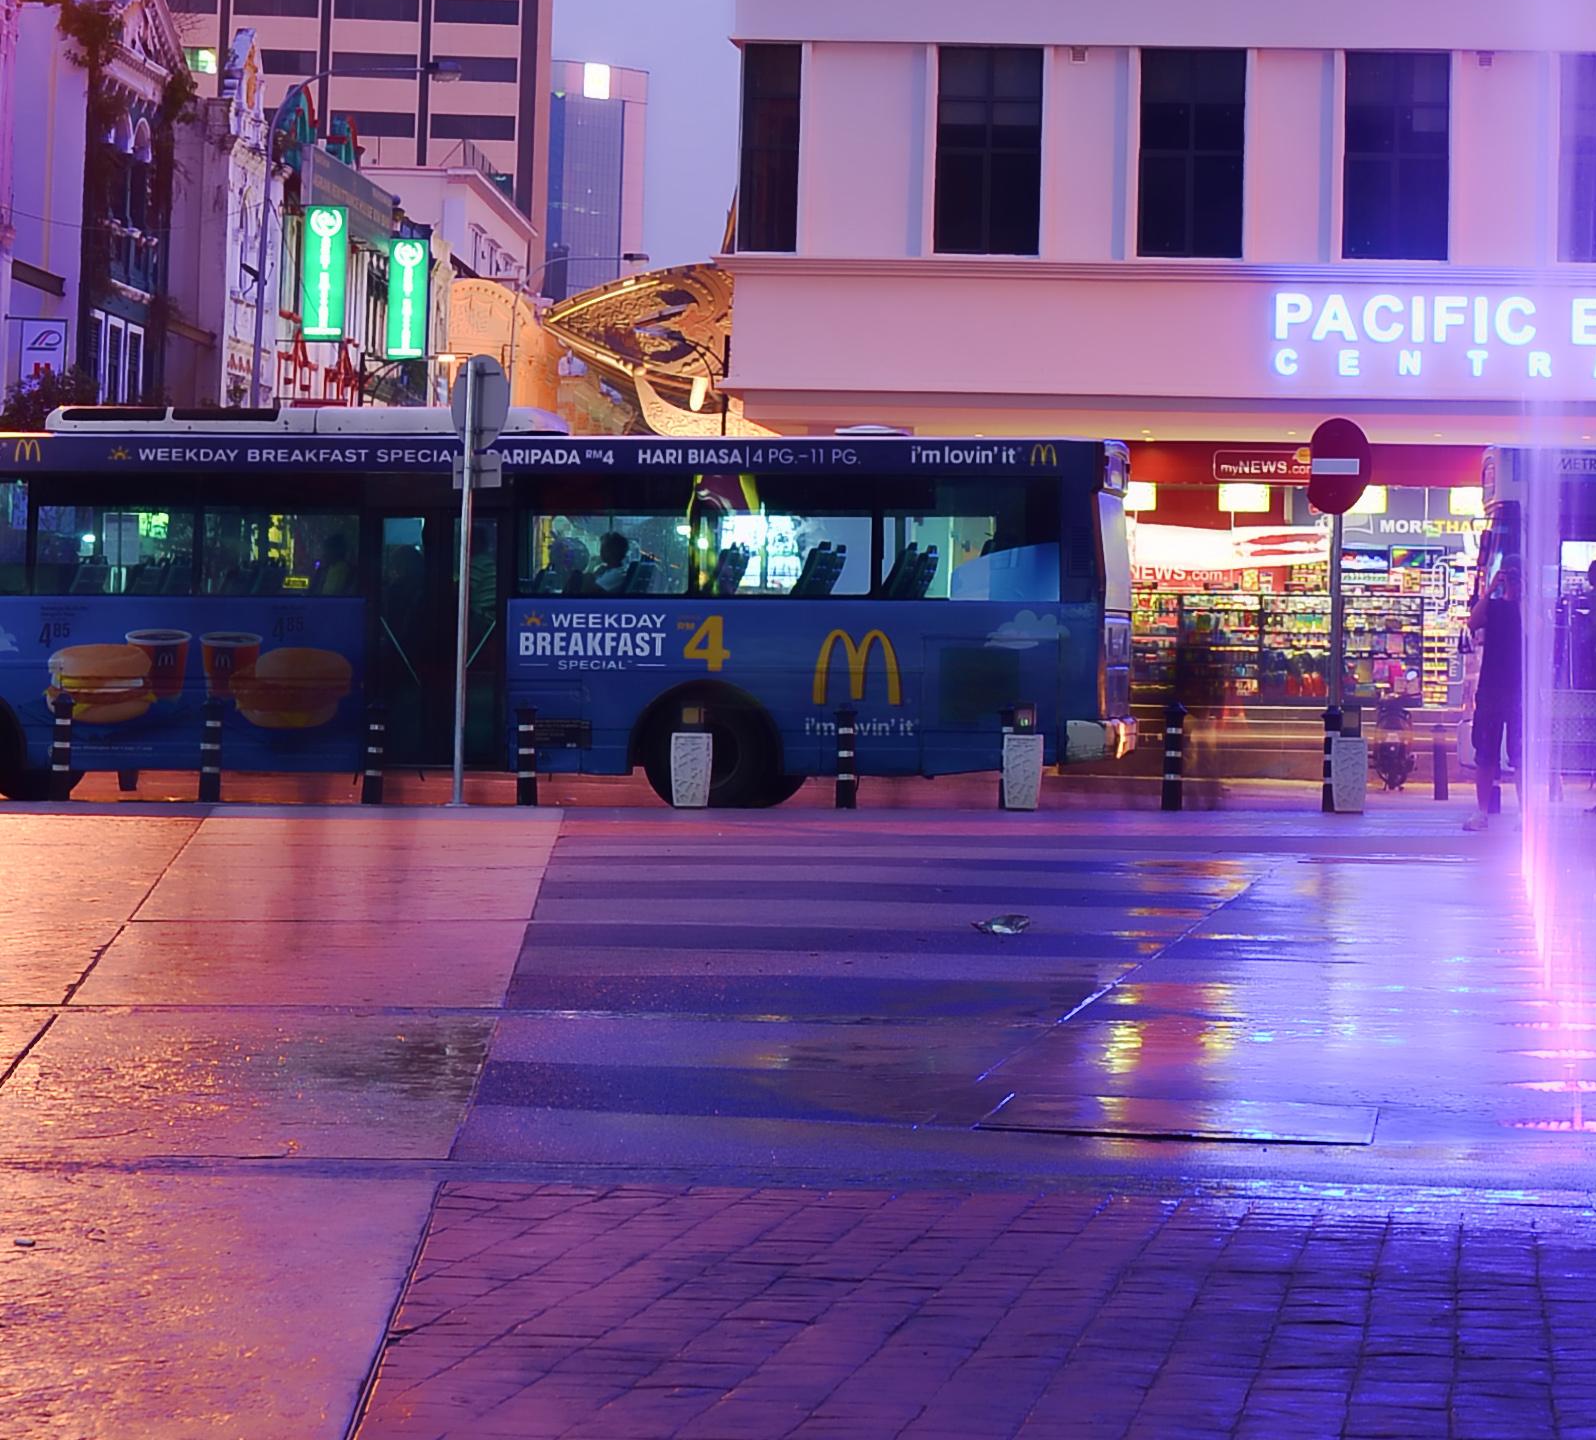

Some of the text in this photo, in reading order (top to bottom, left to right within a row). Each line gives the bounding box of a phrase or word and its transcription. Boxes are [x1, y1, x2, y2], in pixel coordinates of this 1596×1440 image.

[1274, 293, 1537, 344] PACIFIC
[139, 449, 240, 462] WEEKDAY
[247, 448, 369, 463] BREAKFAST
[638, 449, 683, 465] HARI
[688, 449, 742, 465] BIASA
[831, 448, 861, 465] PG.
[911, 446, 941, 464] i'm
[944, 446, 998, 464] lovin'
[551, 613, 667, 629] WEEKDAY
[518, 632, 667, 657] BREAKFAST
[558, 660, 626, 671] SPECIAL
